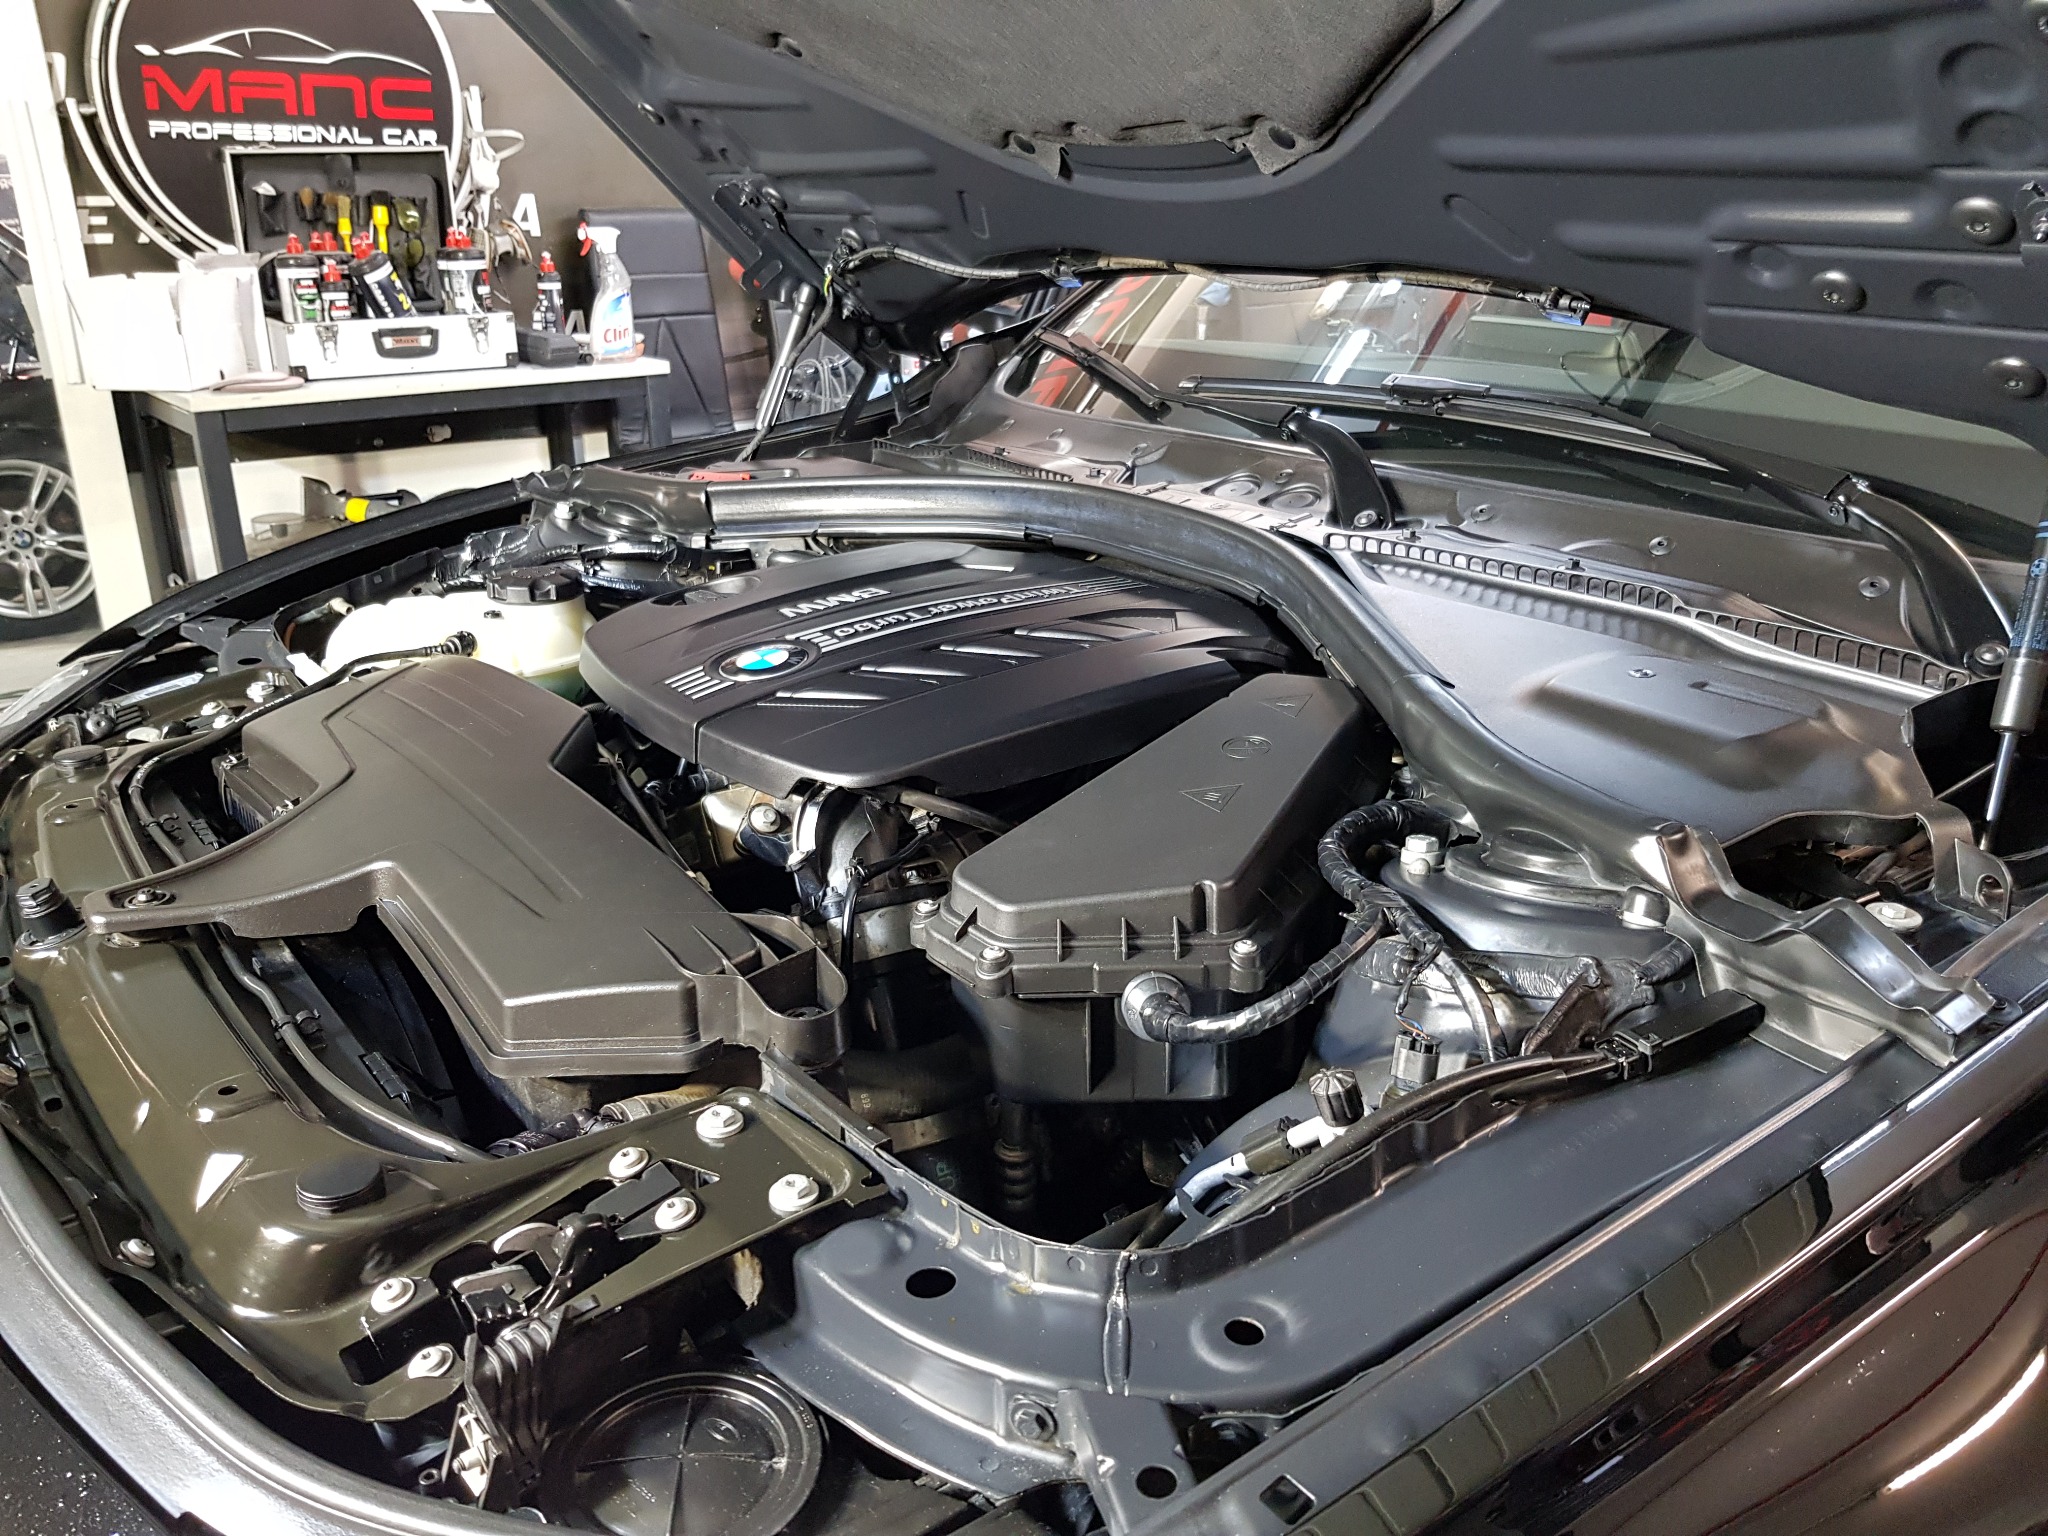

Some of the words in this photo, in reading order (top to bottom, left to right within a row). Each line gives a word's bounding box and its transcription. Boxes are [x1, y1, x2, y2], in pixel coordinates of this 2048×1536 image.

[141, 64, 434, 121] MANC
[148, 120, 373, 145] PROFESSIONAL
[382, 128, 437, 146] CAR
[778, 587, 891, 618] BMW
